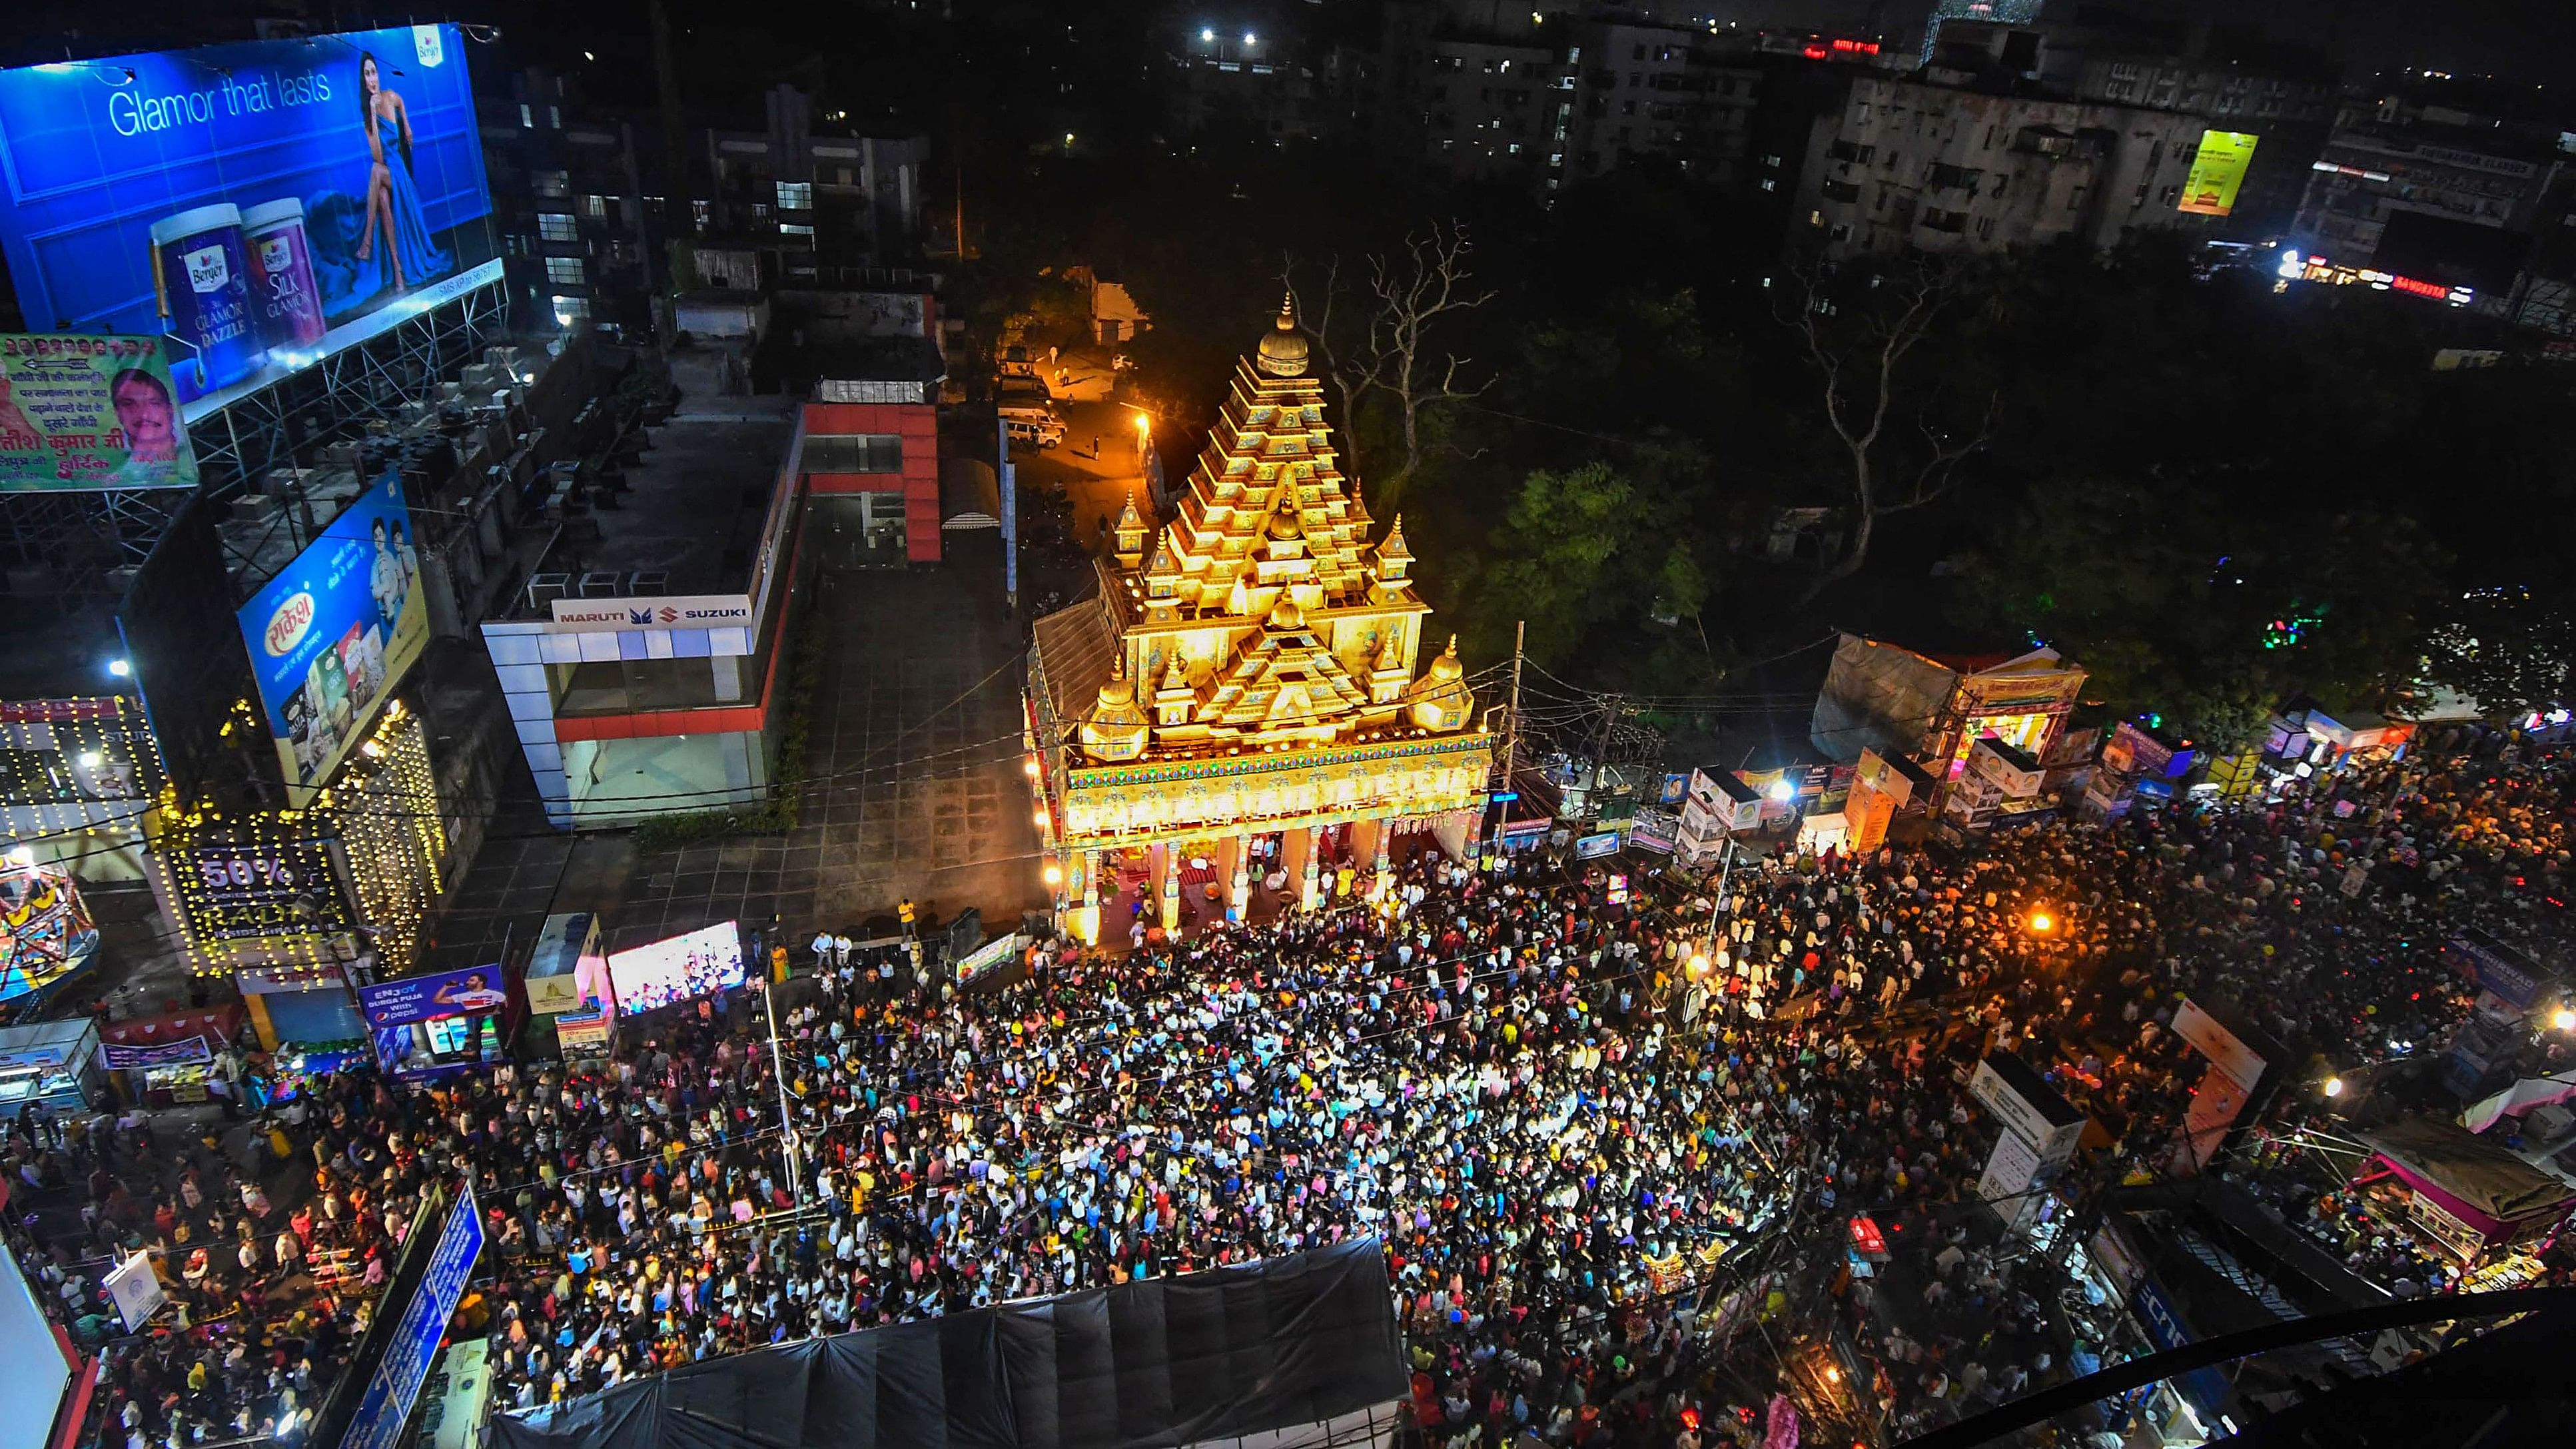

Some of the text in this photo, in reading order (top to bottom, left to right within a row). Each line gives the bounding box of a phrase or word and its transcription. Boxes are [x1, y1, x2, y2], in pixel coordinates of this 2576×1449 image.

[109, 69, 330, 137] Glamor that lasts
[193, 261, 224, 284] Berger
[269, 272, 300, 300] SILK
[438, 284, 454, 295] SMS
[195, 301, 243, 332] GLAMOR
[266, 290, 311, 319] GLAMOR
[201, 319, 246, 348] DAZZLE
[46, 434, 97, 457] कुमार
[102, 427, 125, 449] जी
[268, 596, 311, 654] राकेश
[560, 608, 746, 623] MARUTI SUZUKI
[202, 857, 294, 887] 50%
[368, 993, 423, 1008] DURGA PUJA
[374, 983, 418, 999] ENJOY
[390, 1002, 412, 1012] With
[390, 1008, 418, 1020] pepsi
[422, 1304, 437, 1340] HOUSE
